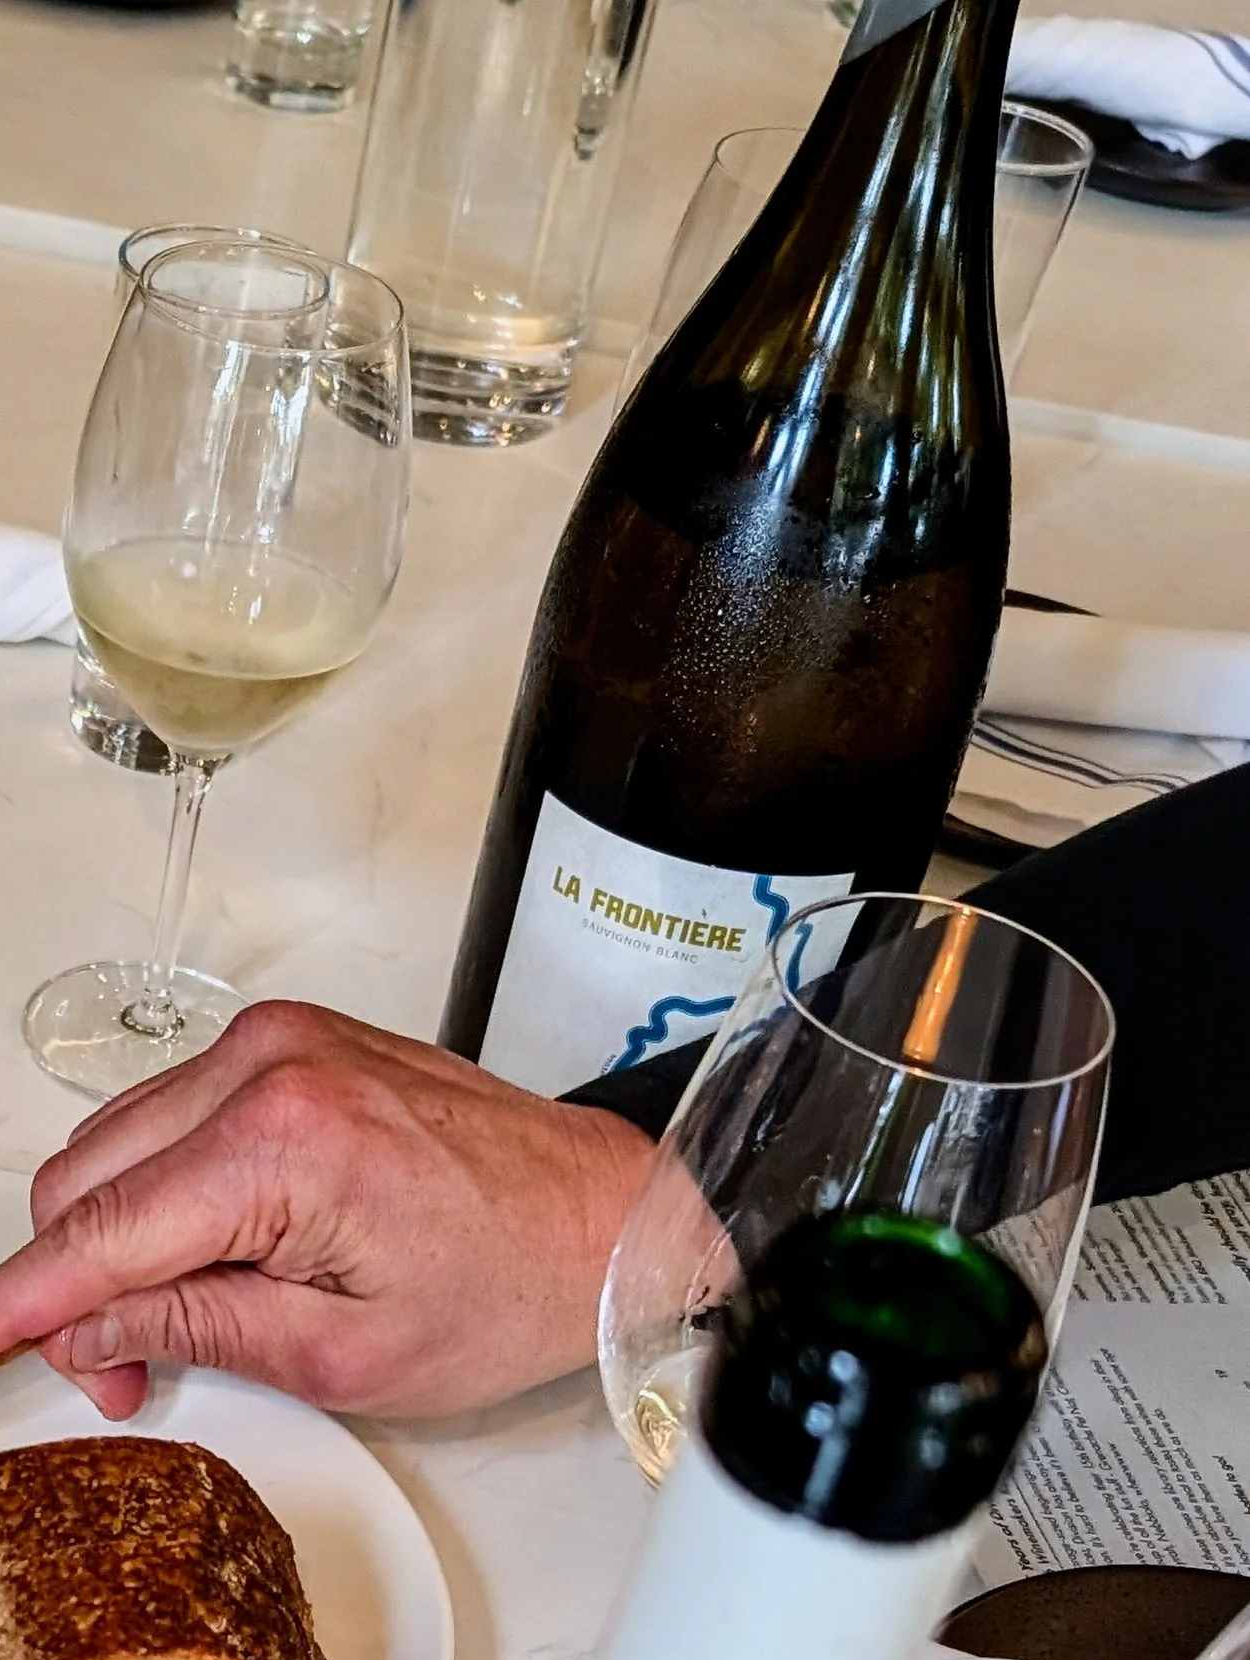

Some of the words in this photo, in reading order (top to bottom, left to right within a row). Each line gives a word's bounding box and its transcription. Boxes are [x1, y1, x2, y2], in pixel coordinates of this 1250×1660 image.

[552, 866, 581, 904] LA
[590, 888, 748, 953] FRONTIÈRE
[582, 918, 651, 952] SAUVIGNON
[656, 946, 699, 965] BLANC
[1121, 1407, 1136, 1425] from
[1132, 1426, 1160, 1467] selections
[1170, 1436, 1181, 1445] as
[1173, 1448, 1195, 1469] much
[1157, 1468, 1177, 1494] library
[1190, 1467, 1202, 1481] as
[1226, 1469, 1237, 1482] to
[1172, 1497, 1185, 1511] are
[1210, 1501, 1227, 1524] love
[1077, 1515, 1097, 1534] hard
[1102, 1493, 1134, 1541] celebrating
[1182, 1513, 1200, 1536] wines
[1194, 1504, 1220, 1541] absolute
[996, 1523, 1013, 1539] of
[1007, 1499, 1050, 1564] Winemakers
[1222, 1522, 1241, 1546] you
[1009, 1539, 1033, 1570] Years
